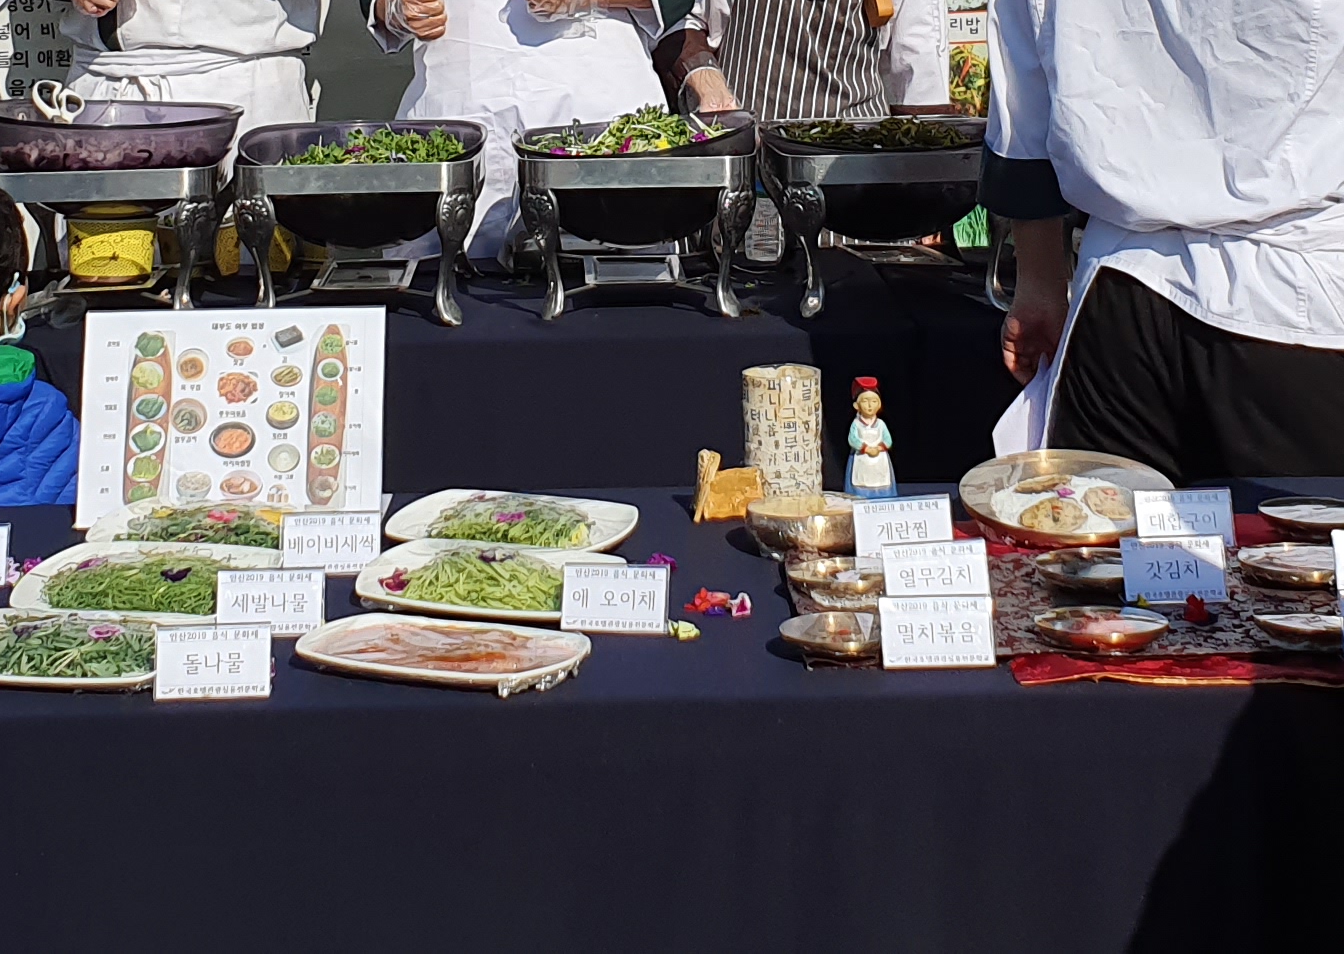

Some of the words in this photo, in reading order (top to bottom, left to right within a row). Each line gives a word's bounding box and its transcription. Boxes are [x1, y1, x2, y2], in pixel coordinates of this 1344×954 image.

[37, 50, 72, 68] 애환
[1149, 511, 1217, 531] 대합구이
[288, 533, 376, 555] 베이비새싹
[899, 564, 973, 588] 열무김치
[1145, 559, 1199, 580] 갓김치
[231, 592, 309, 614] 세발나물
[572, 587, 588, 608] 애
[600, 589, 655, 611] 오이채
[898, 621, 976, 644] 멸치볶음
[183, 651, 245, 676] 돌나물
